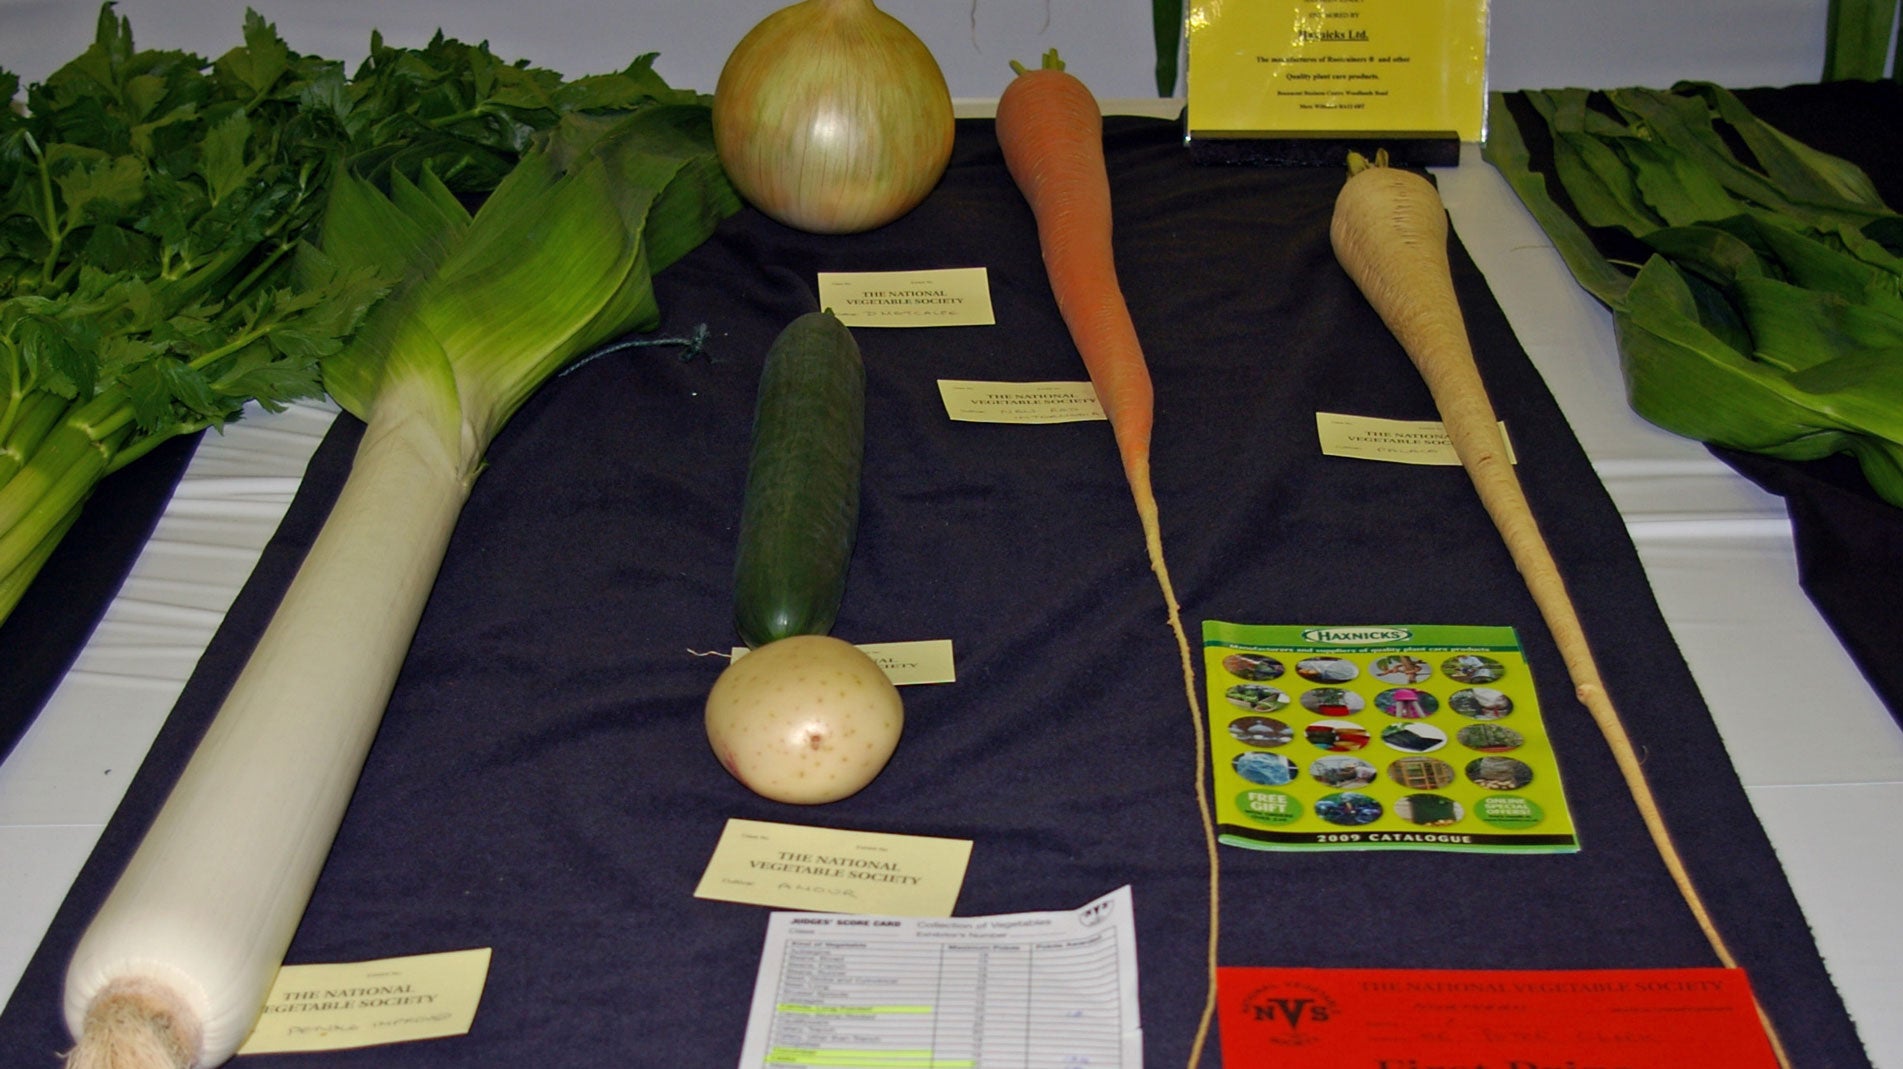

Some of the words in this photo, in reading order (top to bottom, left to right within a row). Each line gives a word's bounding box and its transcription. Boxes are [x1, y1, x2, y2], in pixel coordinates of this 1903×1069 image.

[1349, 30, 1369, 40] Ltd.
[1348, 436, 1419, 445] VEGETABLE
[1319, 631, 1400, 641] HAXNICKS
[1248, 792, 1287, 804] FREE
[1250, 801, 1287, 813] GIFT
[1317, 834, 1361, 843] 2009
[1368, 834, 1473, 844] CATALOGUE
[779, 851, 813, 863] THE
[816, 855, 901, 872] NATIONAL
[749, 860, 845, 878] VEGETABLE
[847, 870, 923, 886] SOCIETY
[991, 919, 1052, 930] Vegetables
[1360, 981, 1400, 992] THE
[1406, 981, 1506, 992] NATIONAL
[1512, 981, 1631, 992] VEGETABLE
[1636, 980, 1723, 992] SOCIETY
[282, 990, 320, 1001] THE
[325, 985, 416, 999] NATIONAL
[263, 1000, 357, 1014] EGETABLE
[358, 994, 439, 1009] SOCIETY
[1254, 998, 1330, 1028] NVS
